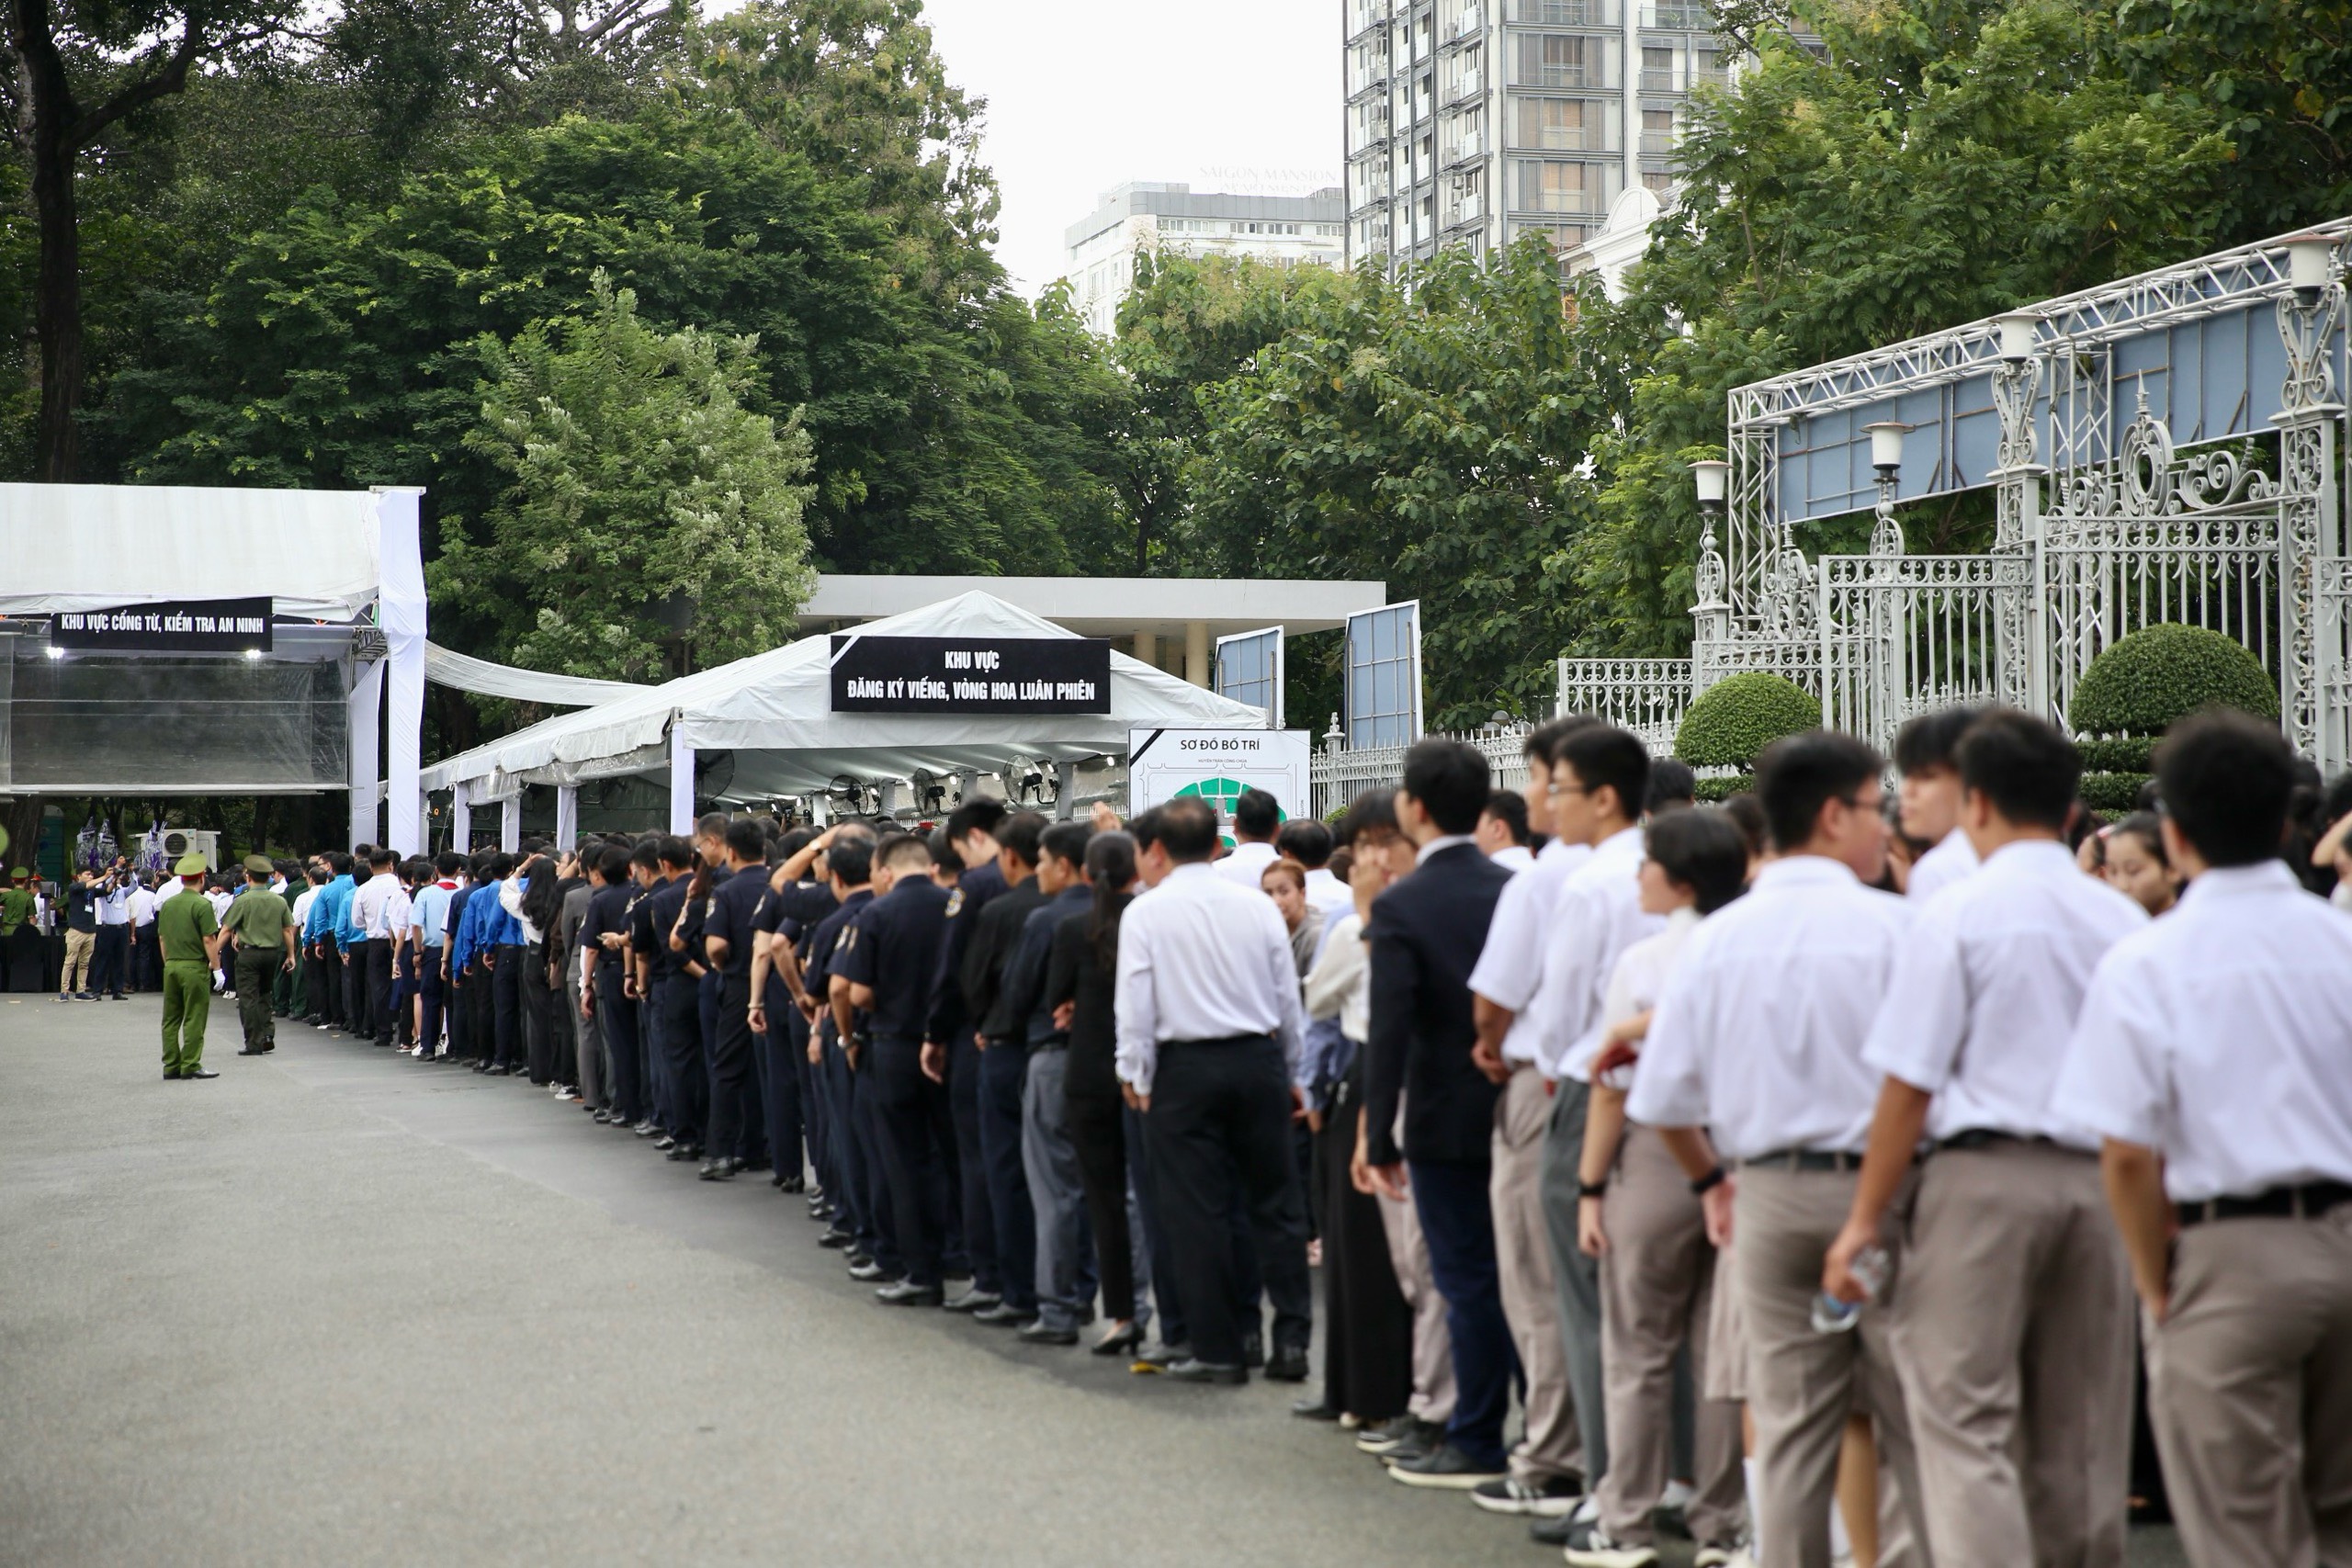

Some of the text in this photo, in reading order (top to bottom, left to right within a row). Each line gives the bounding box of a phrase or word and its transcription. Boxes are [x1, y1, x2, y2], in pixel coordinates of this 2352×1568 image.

[1198, 165, 1337, 182] SAIGON MANSION
[61, 609, 264, 634] KHU VỰC CỔNG TỪ, KIỂM TRA AN NINH
[944, 650, 1000, 673] KHU VỰC
[847, 675, 1095, 702] ĐĂNG KÝ VIẾNG, VÒNG HOA LUÂN PHIÊN
[1181, 739, 1198, 750] SƠ
[1222, 737, 1238, 750] BỐ
[1241, 738, 1261, 750] TRÍ
